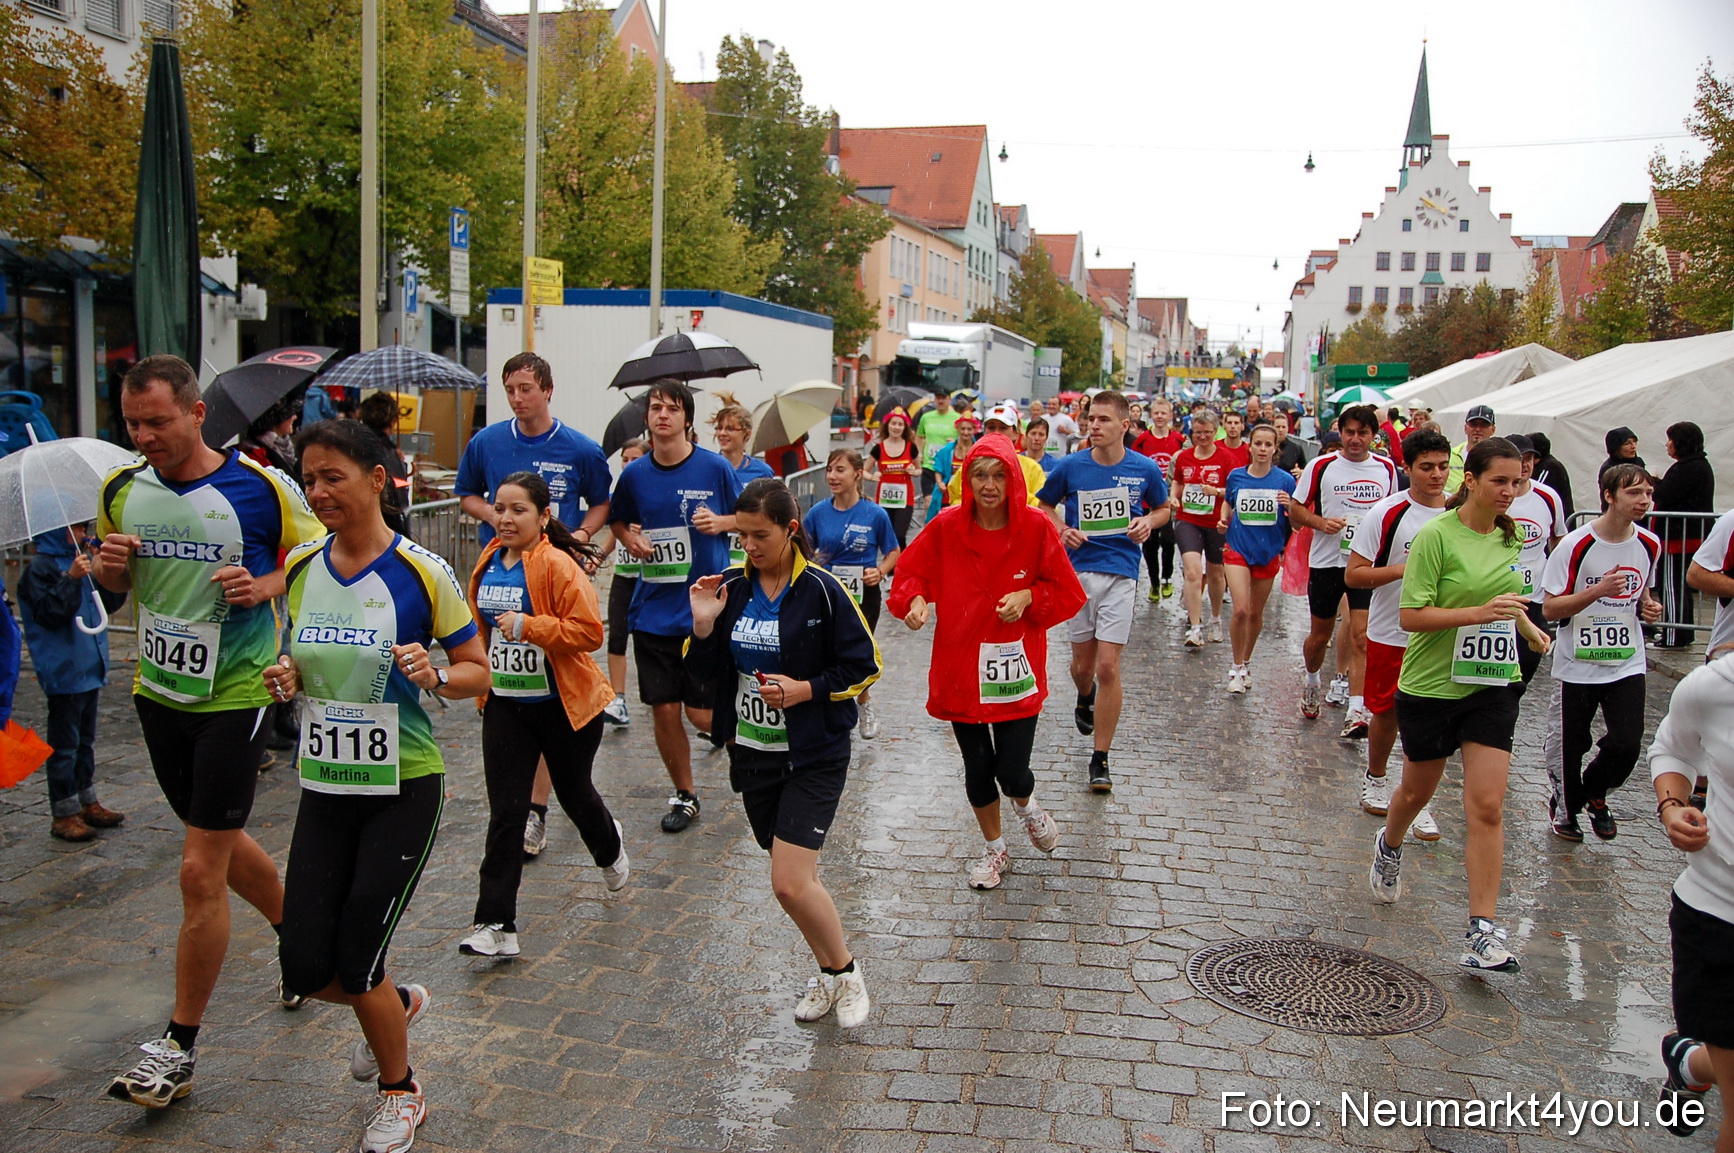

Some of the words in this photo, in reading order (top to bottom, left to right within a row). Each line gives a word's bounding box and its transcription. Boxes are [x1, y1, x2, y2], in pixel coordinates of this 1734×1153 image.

[882, 489, 904, 499] 5047
[1082, 499, 1125, 520] 5219
[1240, 498, 1274, 513] 5208
[133, 523, 191, 539] TEAM
[136, 539, 225, 563] BOCK
[154, 618, 190, 633] BOCK
[308, 612, 353, 626] TEAM
[298, 626, 379, 647] BOCK
[1580, 626, 1630, 647] 5198
[144, 627, 209, 675] 5049
[1461, 635, 1516, 662] 5098
[1588, 651, 1623, 660] Andreas
[491, 645, 538, 673] 5130
[1475, 664, 1505, 677] Katrin
[156, 671, 177, 689] Uwe
[499, 675, 526, 689] Gisela
[998, 682, 1025, 696] Margit
[325, 706, 364, 719] BOCK
[741, 692, 785, 727] 505
[308, 721, 389, 762] 5118
[319, 765, 370, 783] Martina
